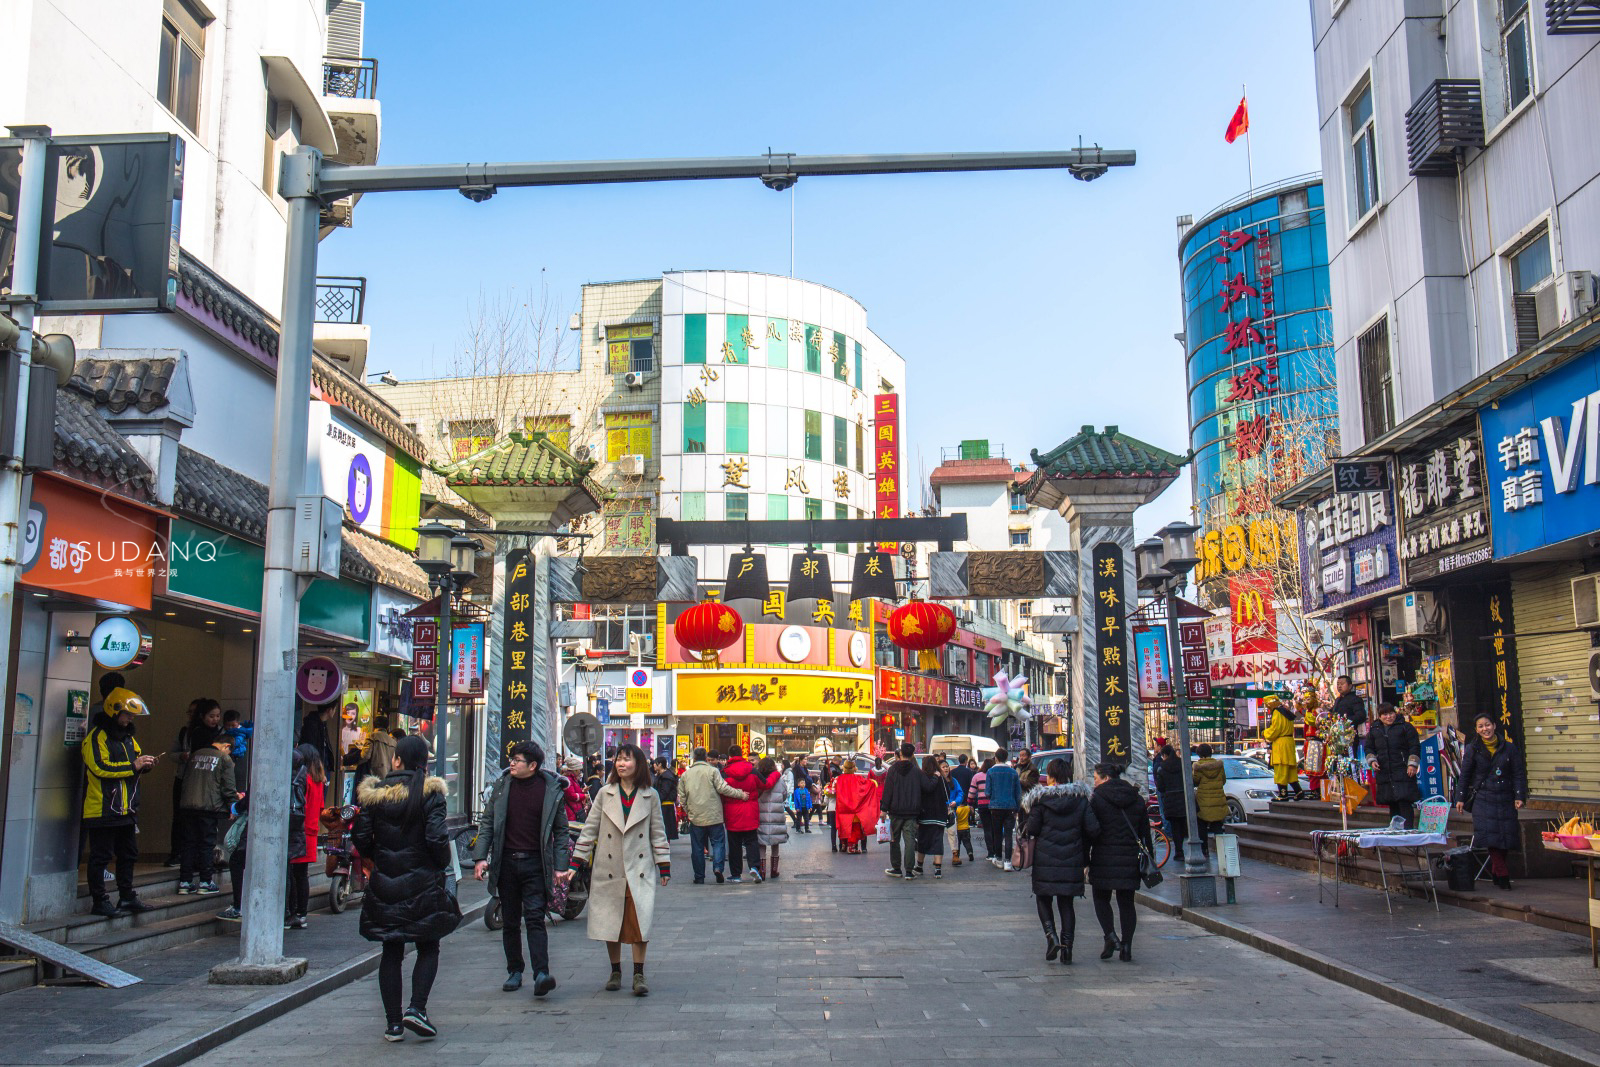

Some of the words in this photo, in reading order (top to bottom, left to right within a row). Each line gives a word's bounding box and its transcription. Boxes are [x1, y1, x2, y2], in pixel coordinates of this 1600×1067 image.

[1498, 426, 1539, 472] 宇宙
[721, 456, 851, 499] 楚风楼
[1338, 464, 1384, 489] 纹身
[49, 536, 87, 574] 都可
[1324, 568, 1344, 587] 江小白
[417, 626, 432, 694] 户部巷
[505, 563, 530, 758] 户部巷里快熱
[1187, 629, 1206, 694] 户部巷
